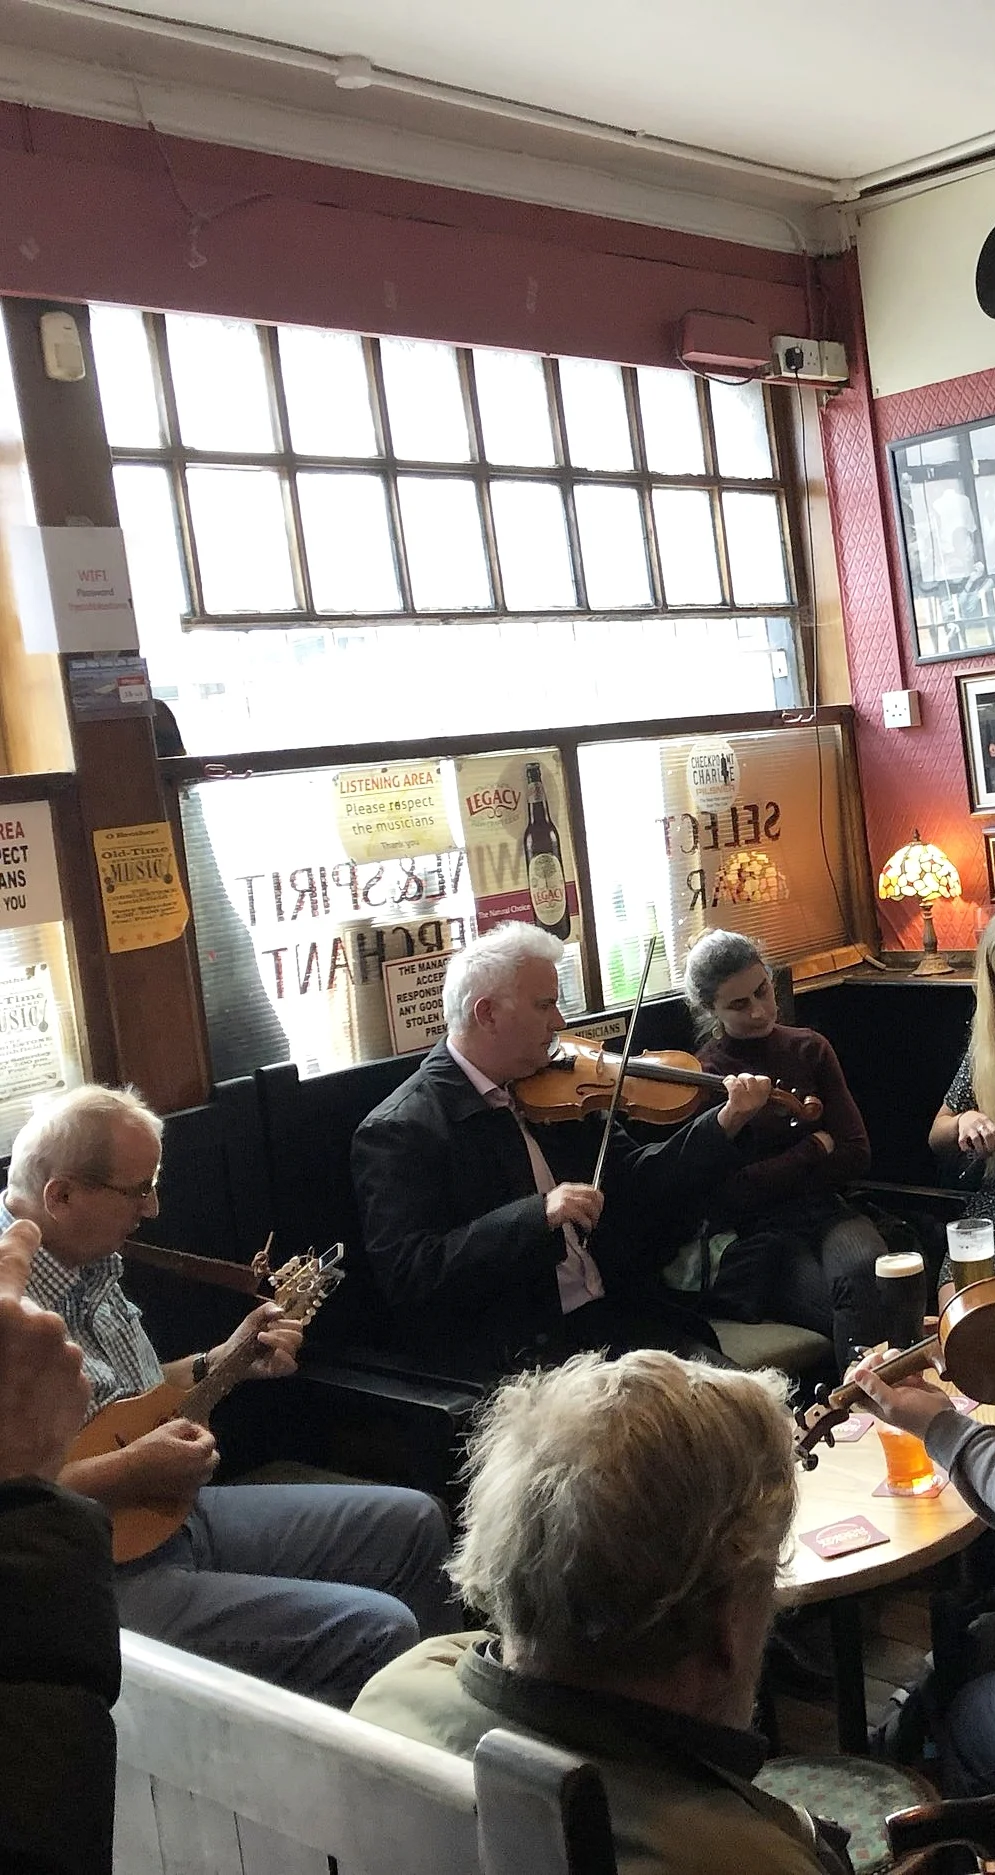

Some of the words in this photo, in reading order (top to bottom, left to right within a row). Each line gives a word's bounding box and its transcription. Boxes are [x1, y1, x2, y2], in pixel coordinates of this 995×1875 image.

[78, 570, 107, 581] WIFI
[340, 775, 400, 793] LISTENING
[403, 772, 433, 786] AREA
[346, 803, 385, 816] Please
[389, 796, 434, 811] respect
[466, 789, 521, 816] LEGACY
[352, 822, 372, 835] the
[376, 816, 434, 832] musicians
[102, 847, 168, 859] Old-Time
[111, 860, 161, 882] MUSIC
[3, 895, 26, 911] YOU
[399, 965, 416, 976] THE
[419, 958, 449, 971] MANAG
[417, 972, 446, 985] ACCEP
[397, 985, 443, 1003] RESPONSI
[400, 1005, 416, 1016] ANY
[420, 999, 443, 1011] GOOD
[406, 1013, 439, 1028] STOLEN
[426, 1023, 448, 1037] PREM
